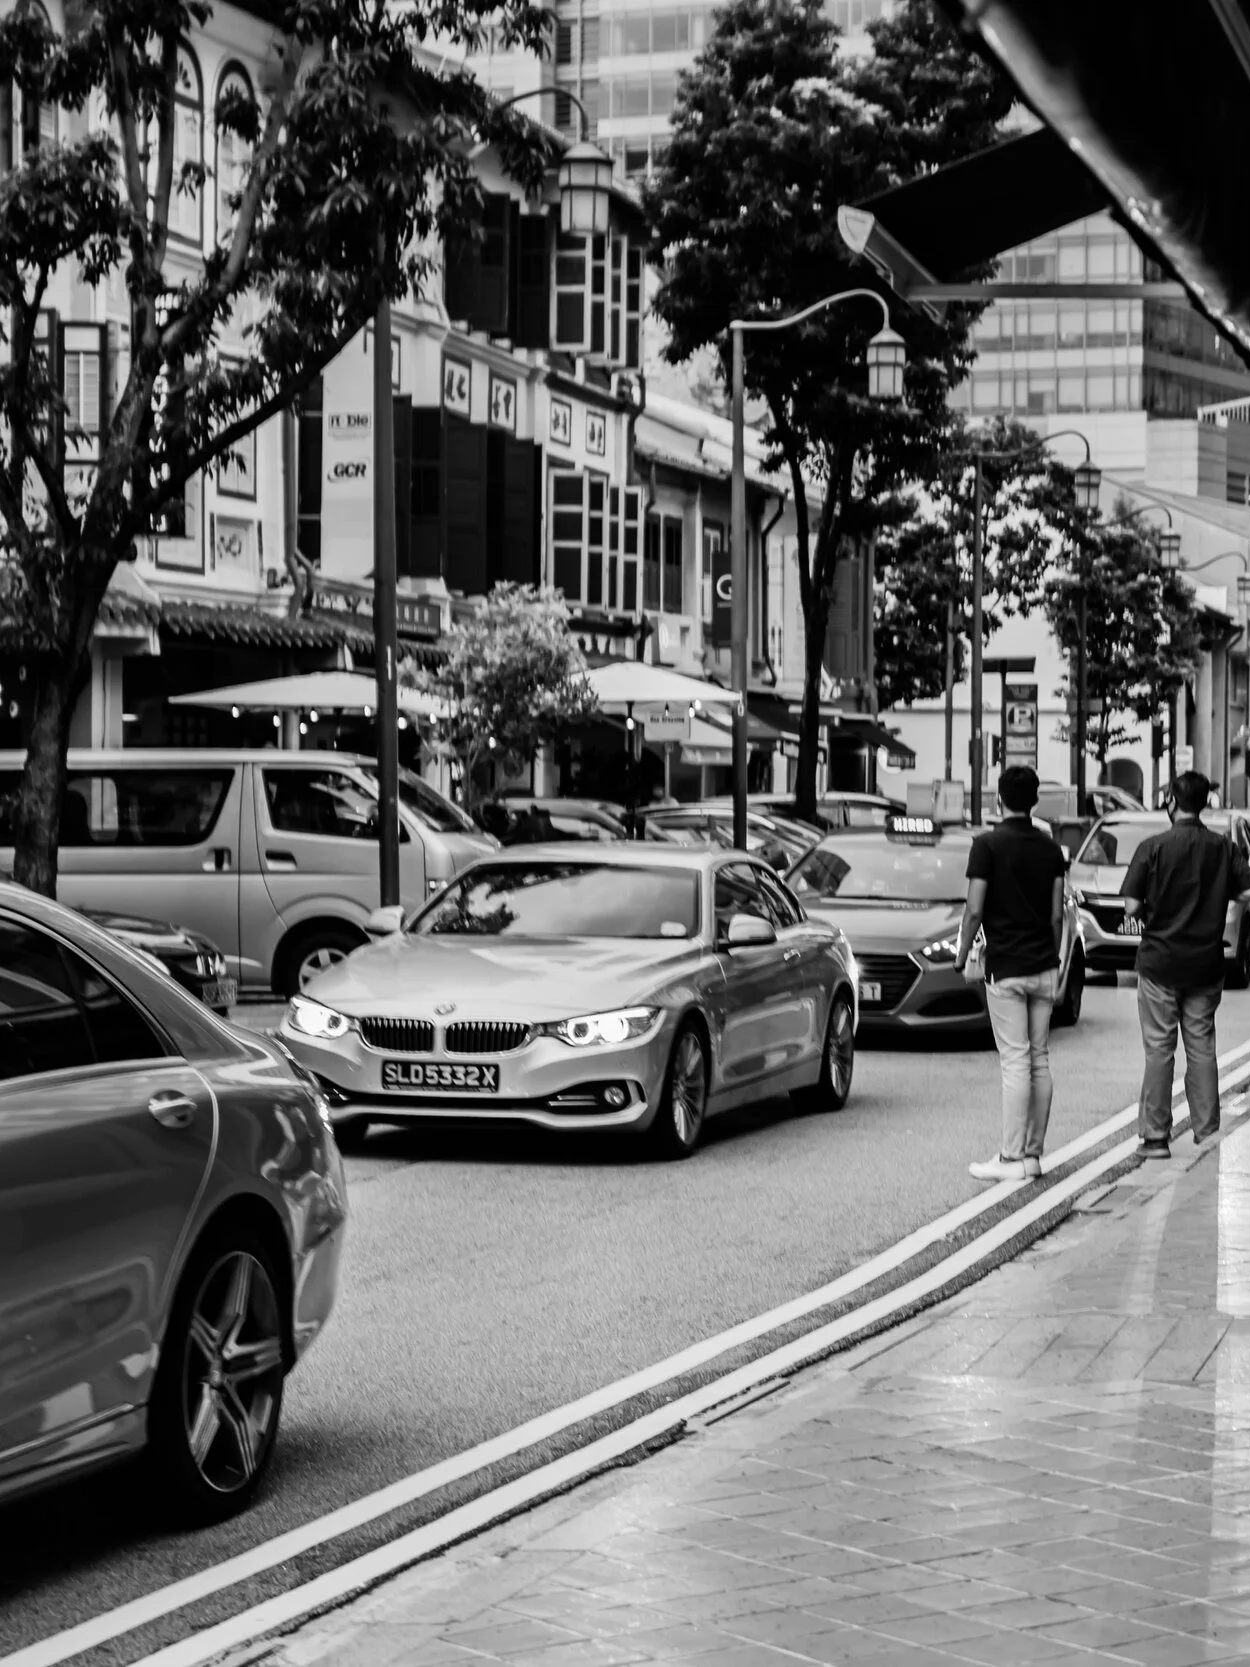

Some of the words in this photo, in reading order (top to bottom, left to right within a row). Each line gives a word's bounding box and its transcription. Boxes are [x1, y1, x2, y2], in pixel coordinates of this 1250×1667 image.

[329, 413, 369, 428] nble
[893, 817, 933, 833] HIRED
[384, 1063, 497, 1087] SLD5332X
